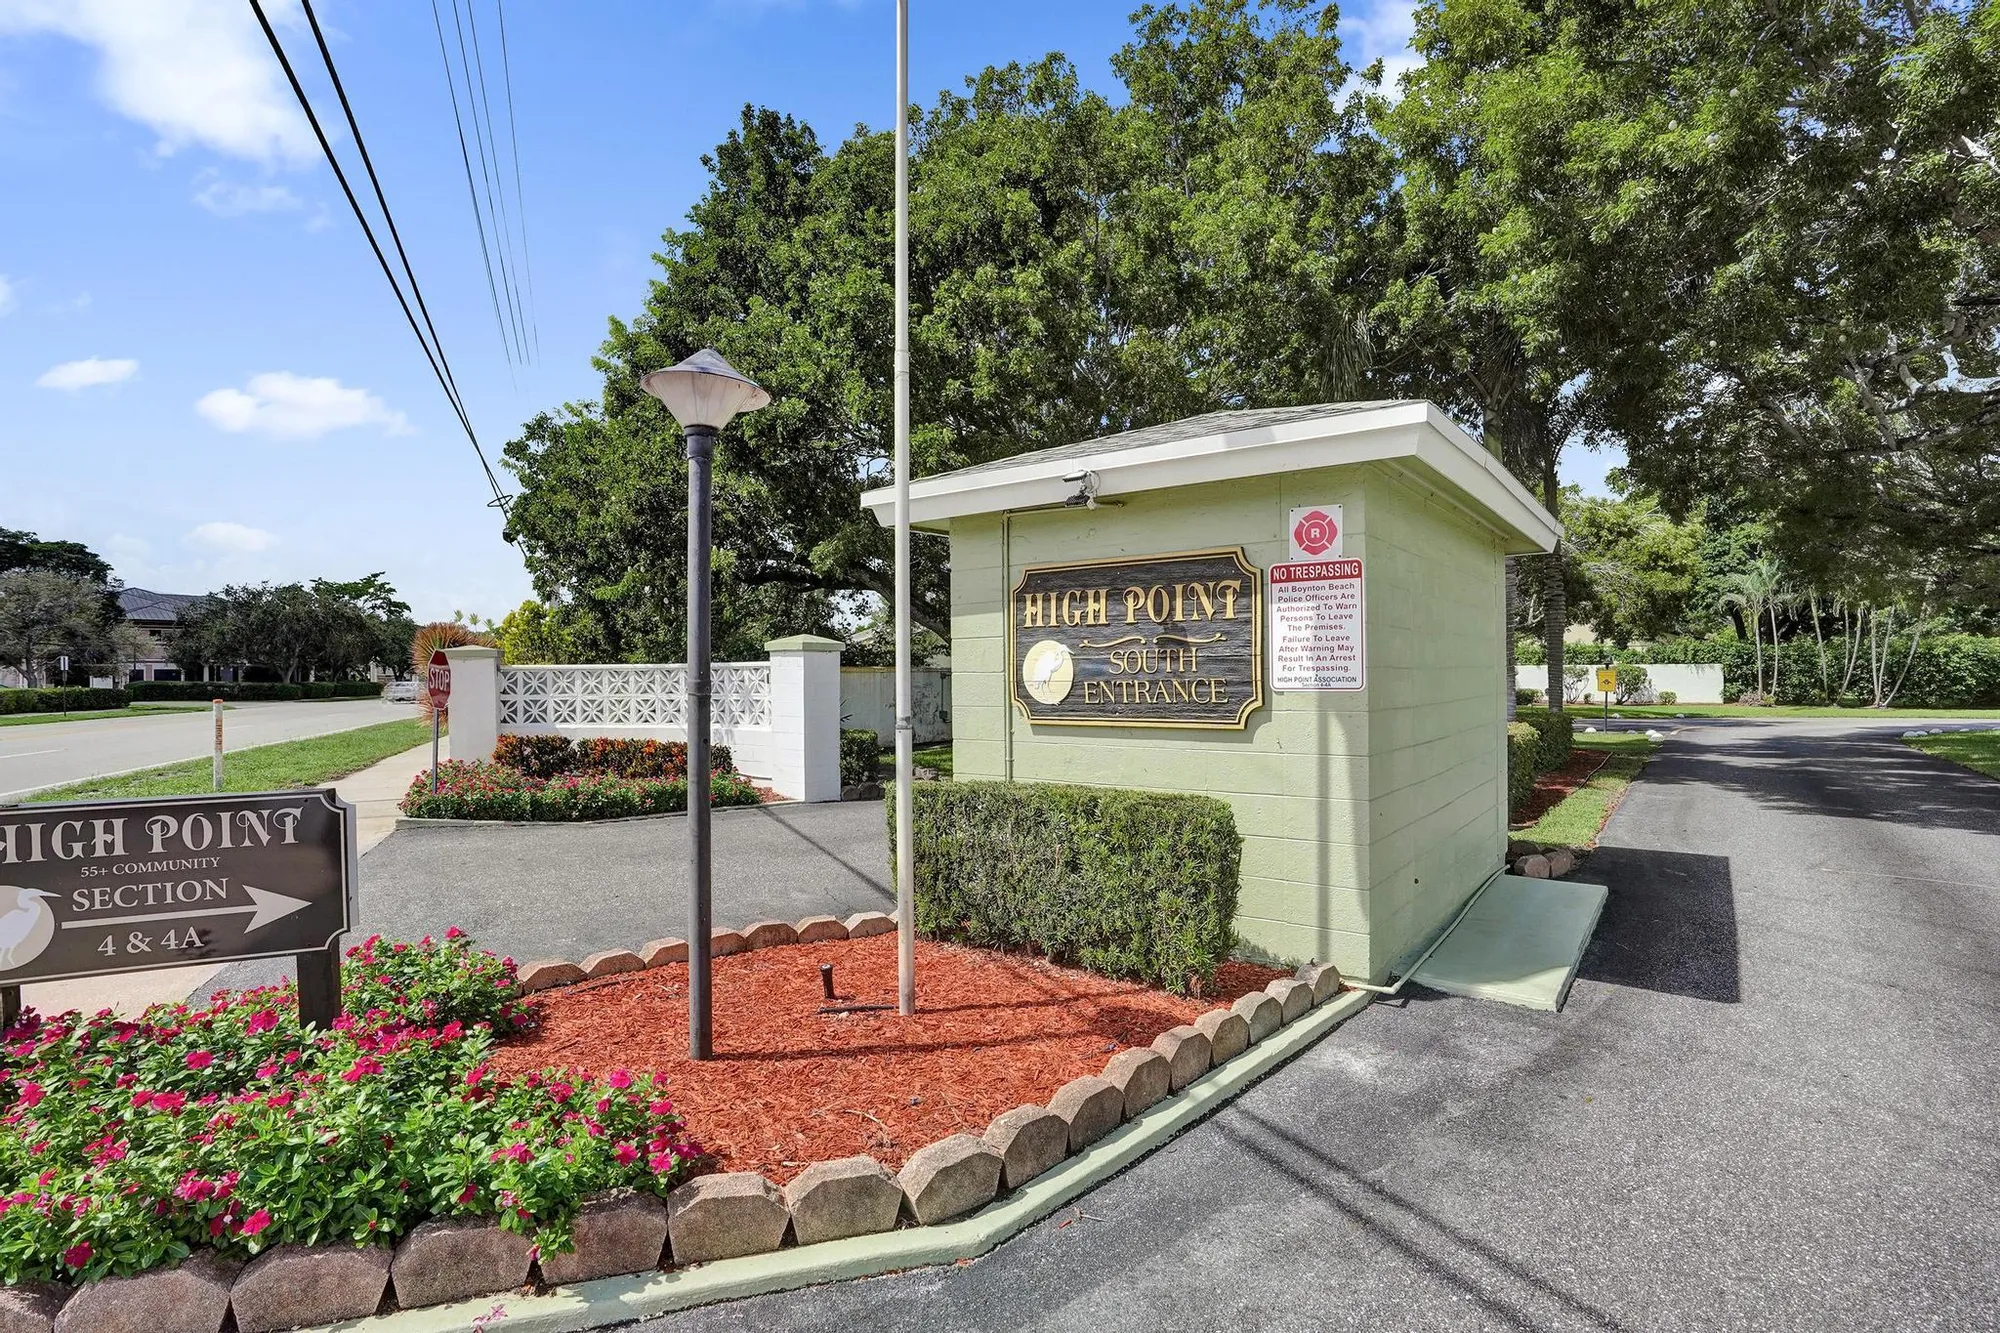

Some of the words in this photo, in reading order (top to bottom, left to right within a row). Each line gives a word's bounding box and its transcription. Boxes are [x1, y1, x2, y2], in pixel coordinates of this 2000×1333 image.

[1273, 567, 1287, 580] NO
[1290, 562, 1359, 579] TRESPASSING
[1291, 585, 1326, 594] Boynton
[1328, 582, 1355, 591] Beach
[1305, 594, 1338, 602] Officers
[1340, 592, 1355, 600] Are
[1023, 588, 1110, 628] HIGH
[1122, 579, 1241, 625] POINT
[1276, 604, 1321, 612] Authorized
[1335, 602, 1357, 610] Warn
[1304, 623, 1346, 631] Premises.
[1282, 635, 1311, 643] Failure
[1300, 644, 1335, 653] Warning
[1337, 644, 1355, 652] May
[1109, 648, 1199, 675] SOUTH
[1315, 654, 1328, 662] An
[1298, 664, 1351, 673] Trespassing.
[430, 667, 450, 691] STOP
[1084, 677, 1230, 705] ENTRANCE
[145, 806, 304, 854] POINT
[80, 865, 109, 878] 55+
[112, 856, 221, 876] COMMUNITY
[72, 877, 230, 912] SECTION
[97, 934, 117, 956] 4
[126, 931, 152, 954] &
[160, 926, 205, 950] 4A
